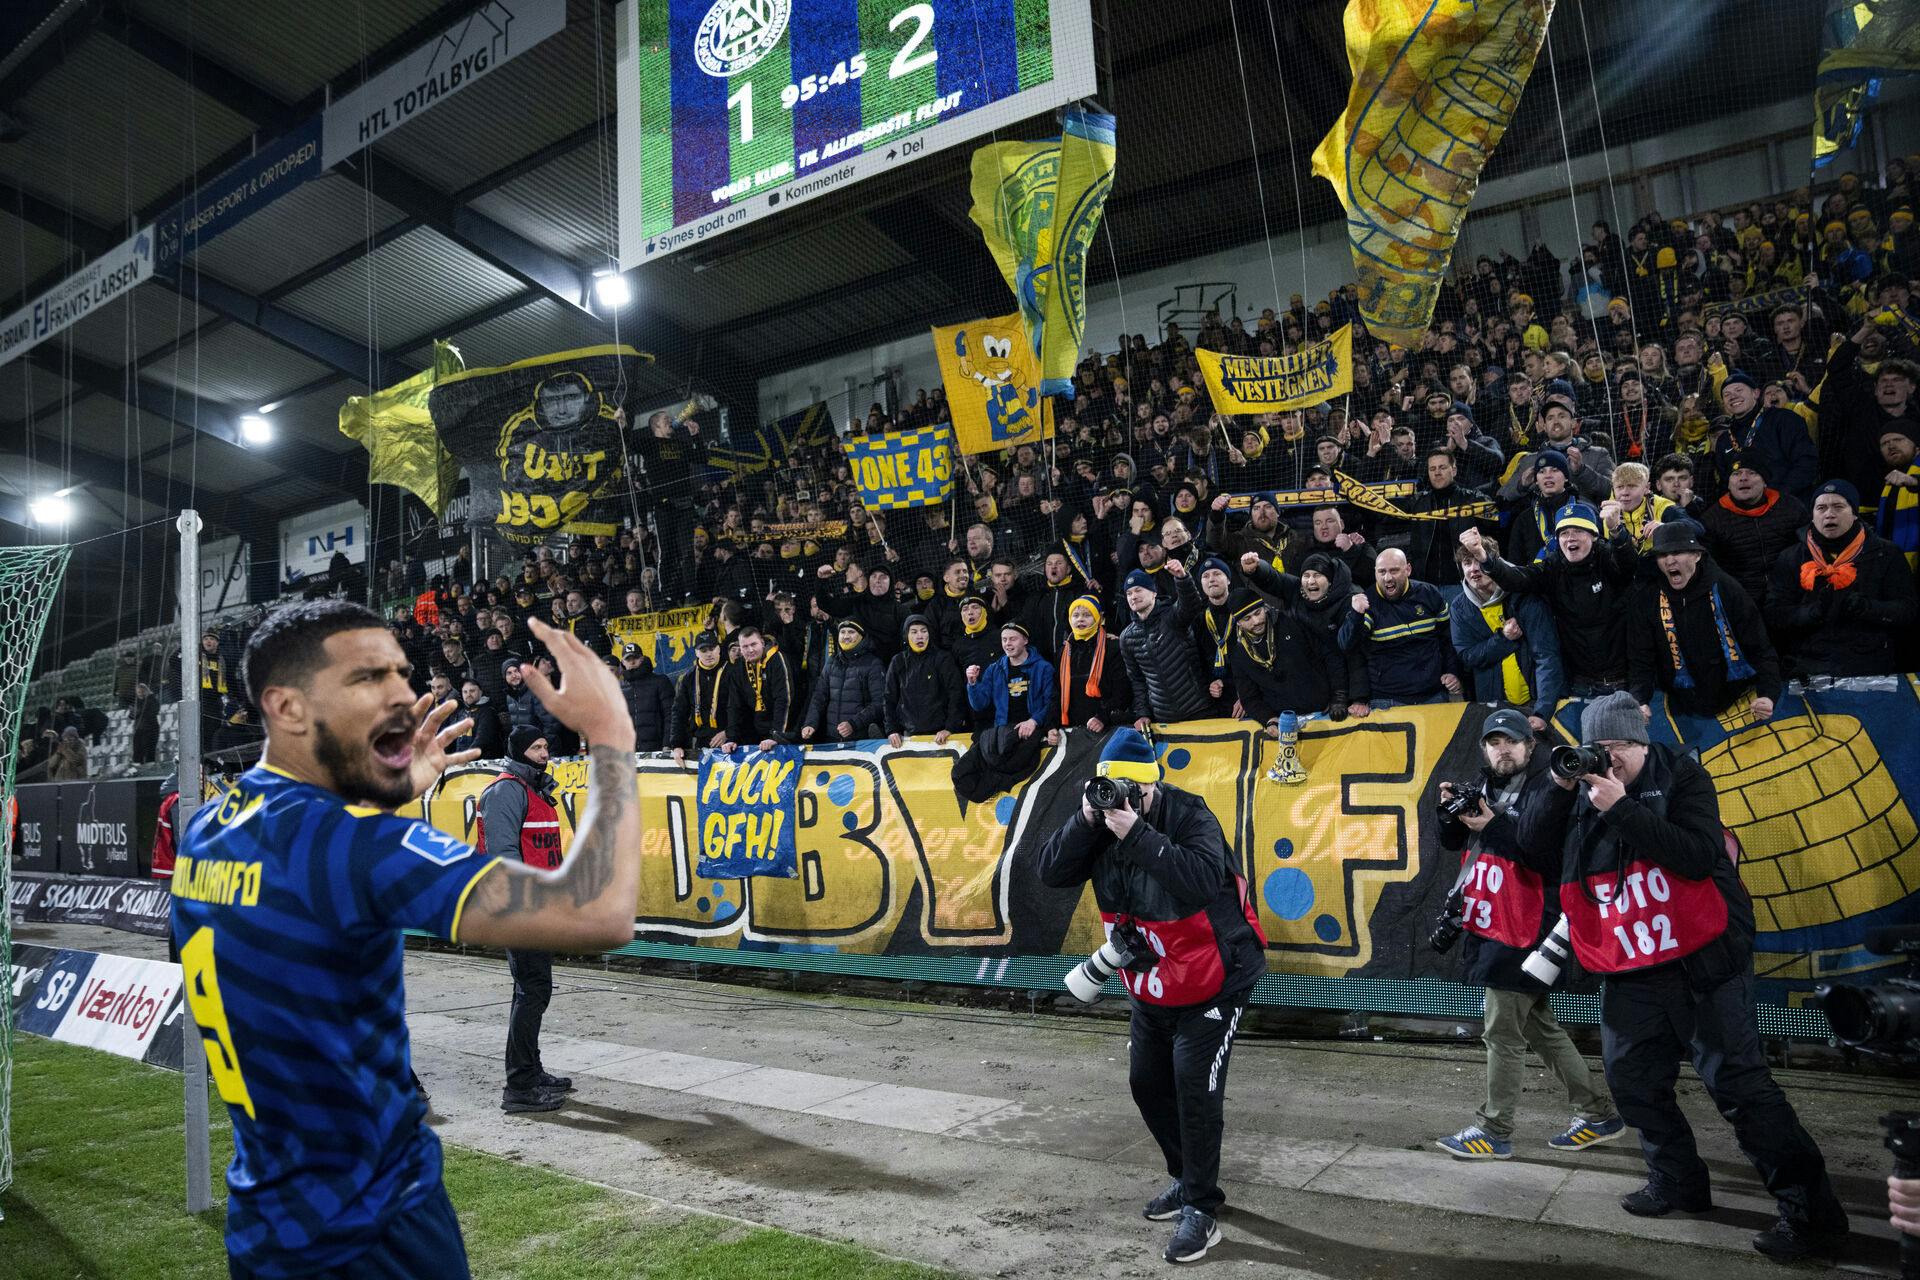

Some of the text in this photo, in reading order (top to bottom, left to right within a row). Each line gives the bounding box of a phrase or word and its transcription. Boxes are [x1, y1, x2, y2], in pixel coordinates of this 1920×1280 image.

[888, 3, 938, 80] 2
[358, 46, 488, 143] HTL TOTALBYG
[780, 53, 868, 110] 95:45
[727, 80, 754, 144] 1
[902, 137, 925, 158] Del
[216, 182, 249, 216] SPORT
[250, 177, 259, 196] &
[259, 140, 317, 189] ORTOPÆDI
[785, 162, 856, 202] Kommentér
[659, 206, 748, 252] Synes godt om
[50, 258, 139, 332] FRANTS LARSEN
[917, 444, 952, 484] 43
[308, 526, 353, 556] NH
[658, 608, 699, 629] UNITY
[701, 758, 795, 806] FUCK
[76, 822, 128, 846] MIDTBUS
[702, 808, 785, 861] GFH!
[40, 881, 128, 910] SKANLUX
[1594, 867, 1670, 919] FOTO
[1613, 914, 1679, 960] 182
[36, 970, 78, 1012] SB
[180, 926, 256, 1120] 9
